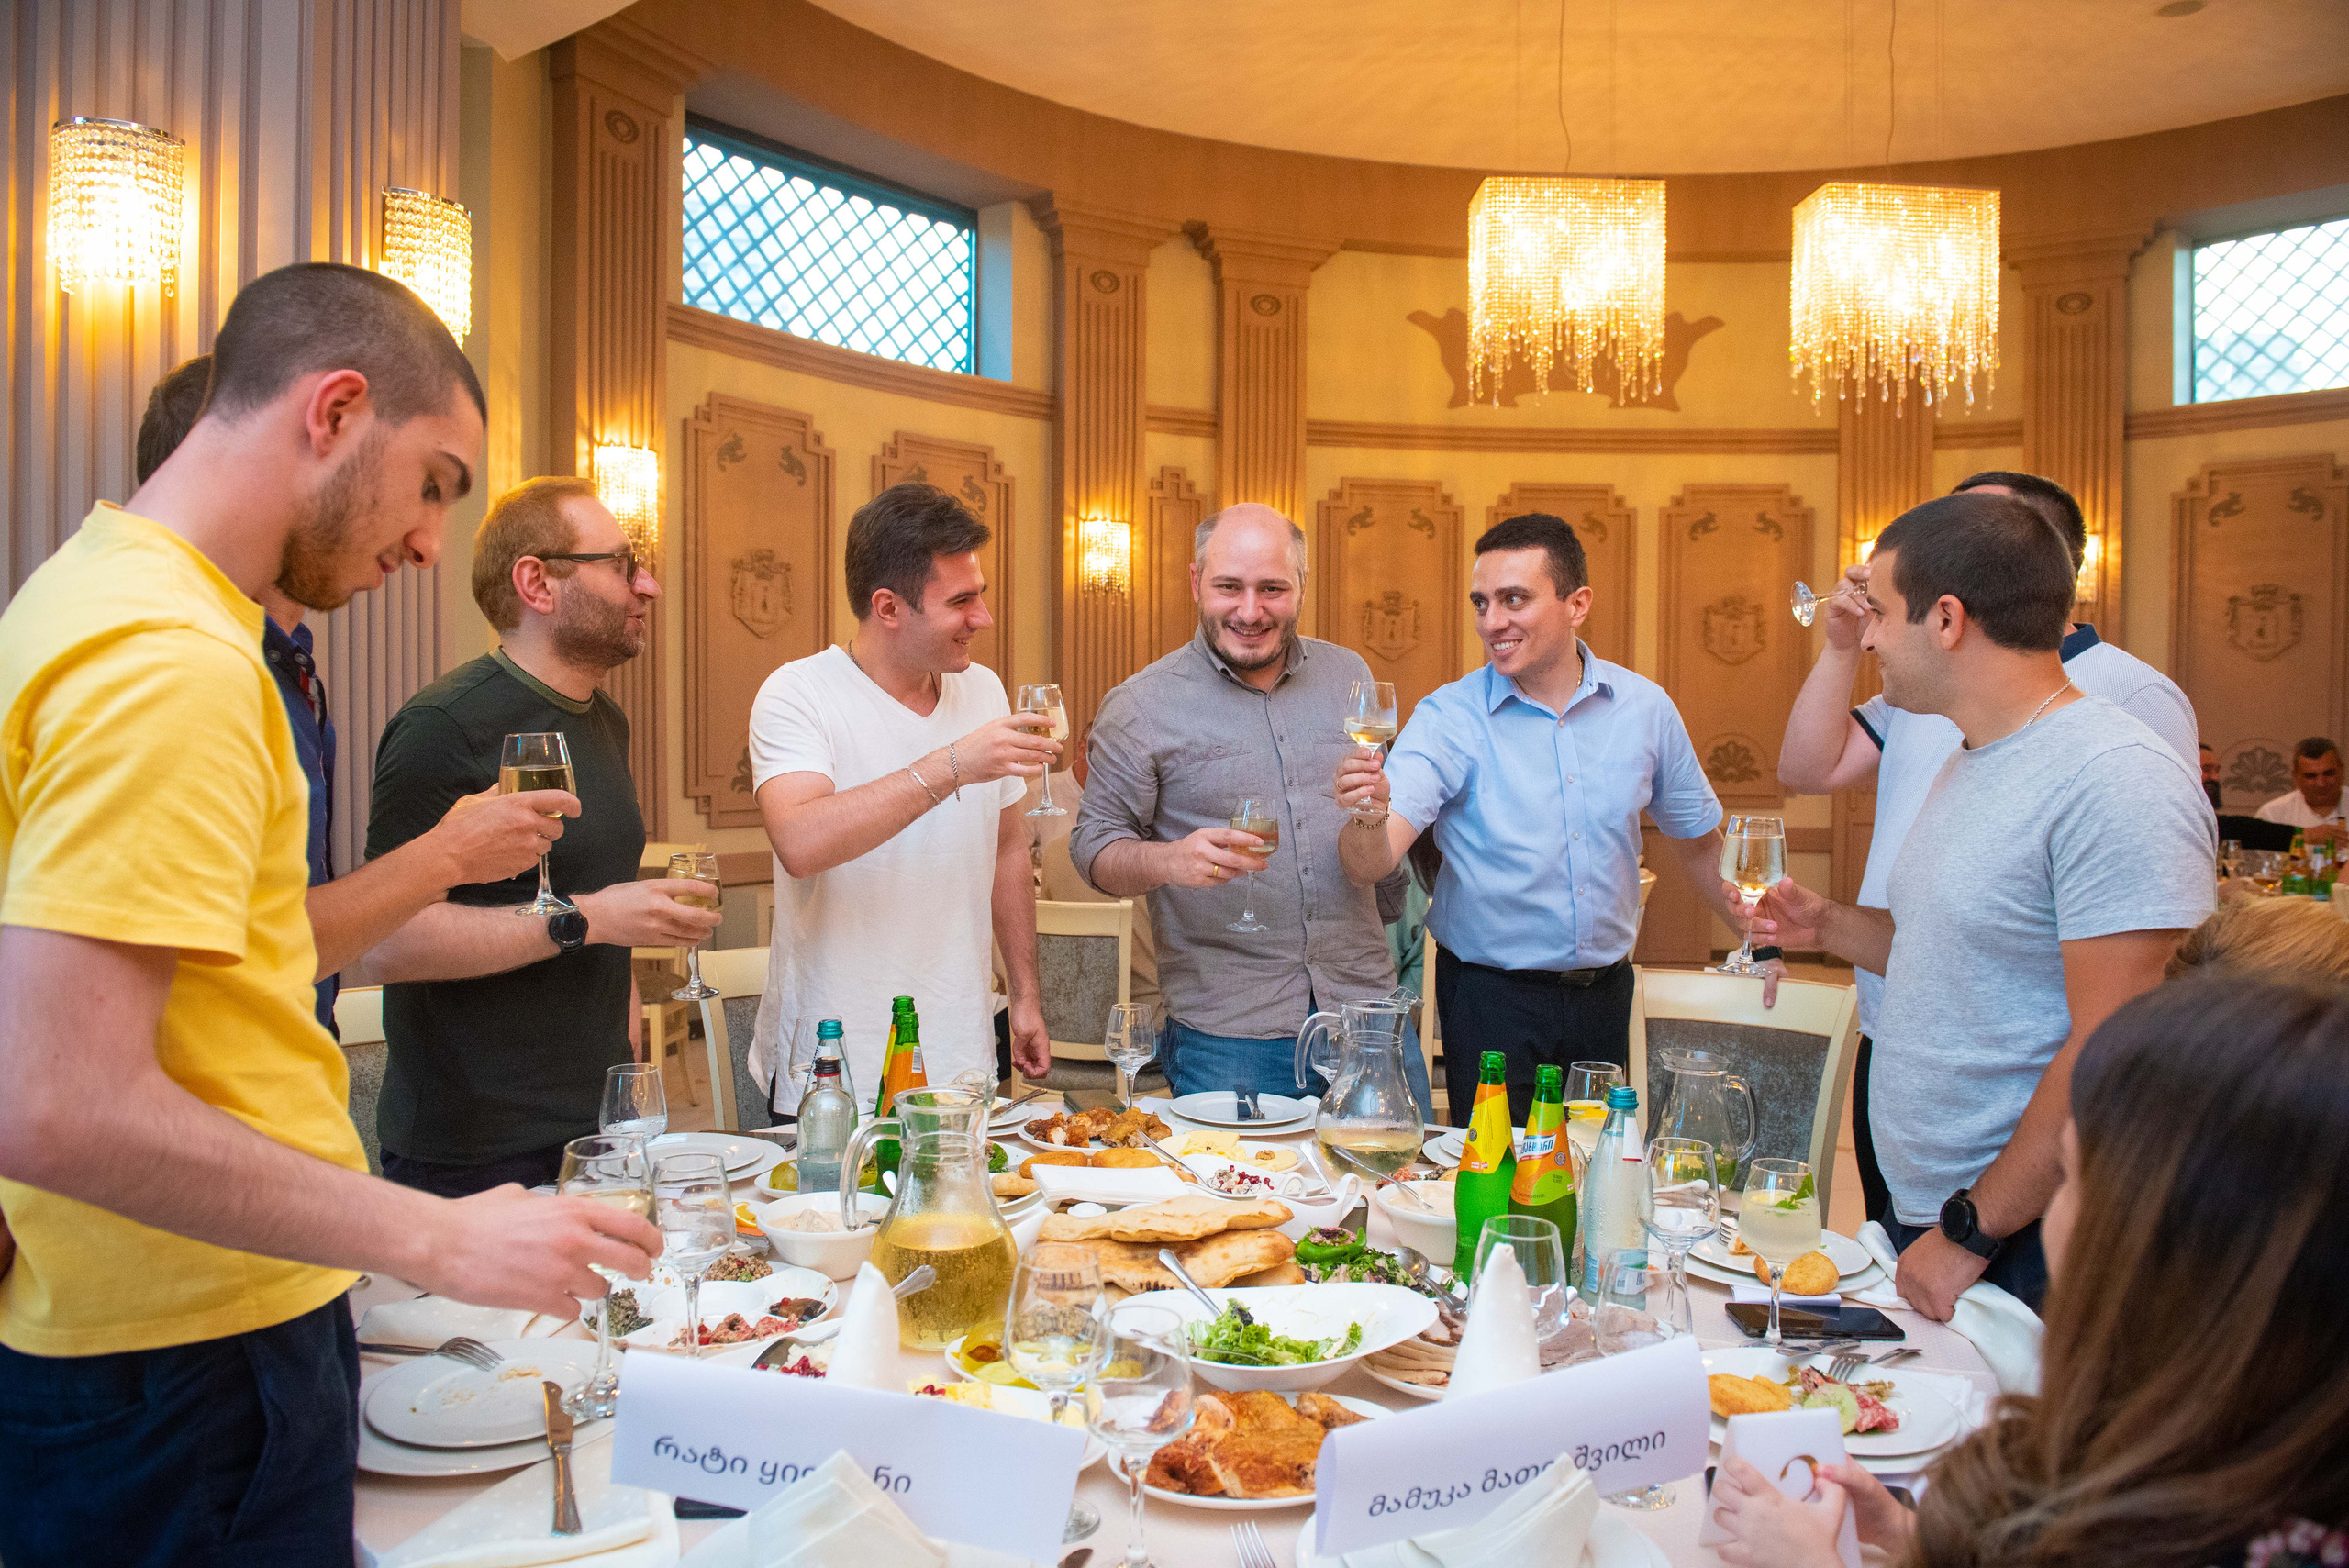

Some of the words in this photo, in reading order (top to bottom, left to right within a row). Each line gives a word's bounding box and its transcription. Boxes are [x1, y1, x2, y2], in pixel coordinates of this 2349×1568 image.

[654, 1436, 748, 1475] რატი
[759, 1460, 912, 1495] ყინი
[1368, 1479, 1472, 1517] მამუკა
[1481, 1431, 1666, 1494] მათშვილი
